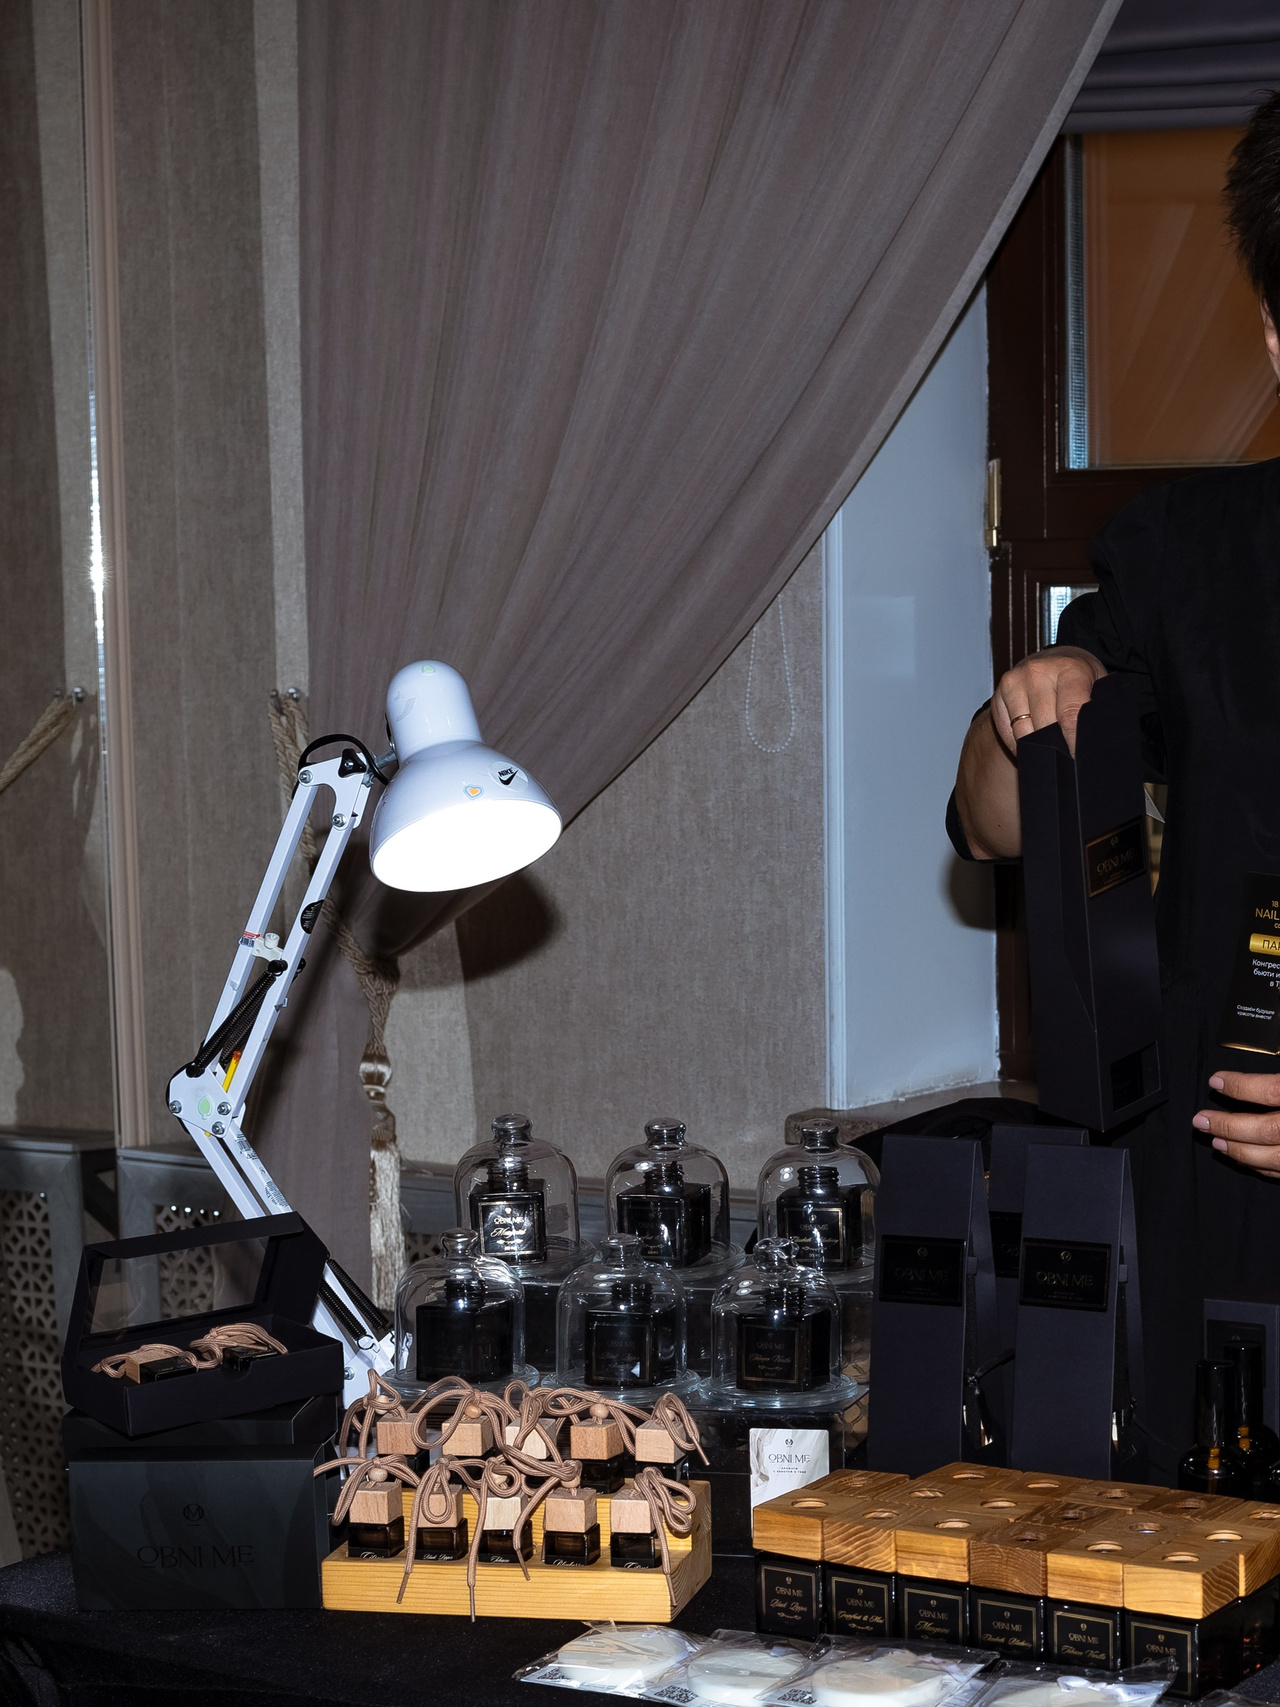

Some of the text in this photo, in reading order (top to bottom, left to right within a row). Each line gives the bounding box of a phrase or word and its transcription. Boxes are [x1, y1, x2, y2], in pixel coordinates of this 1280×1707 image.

[498, 768, 514, 777] NIKE
[1272, 900, 1278, 908] 18
[1255, 908, 1280, 921] NAIL
[1253, 968, 1275, 978] бьюти
[768, 1454, 811, 1463] OBNI ME
[137, 1545, 255, 1568] OBNI ME
